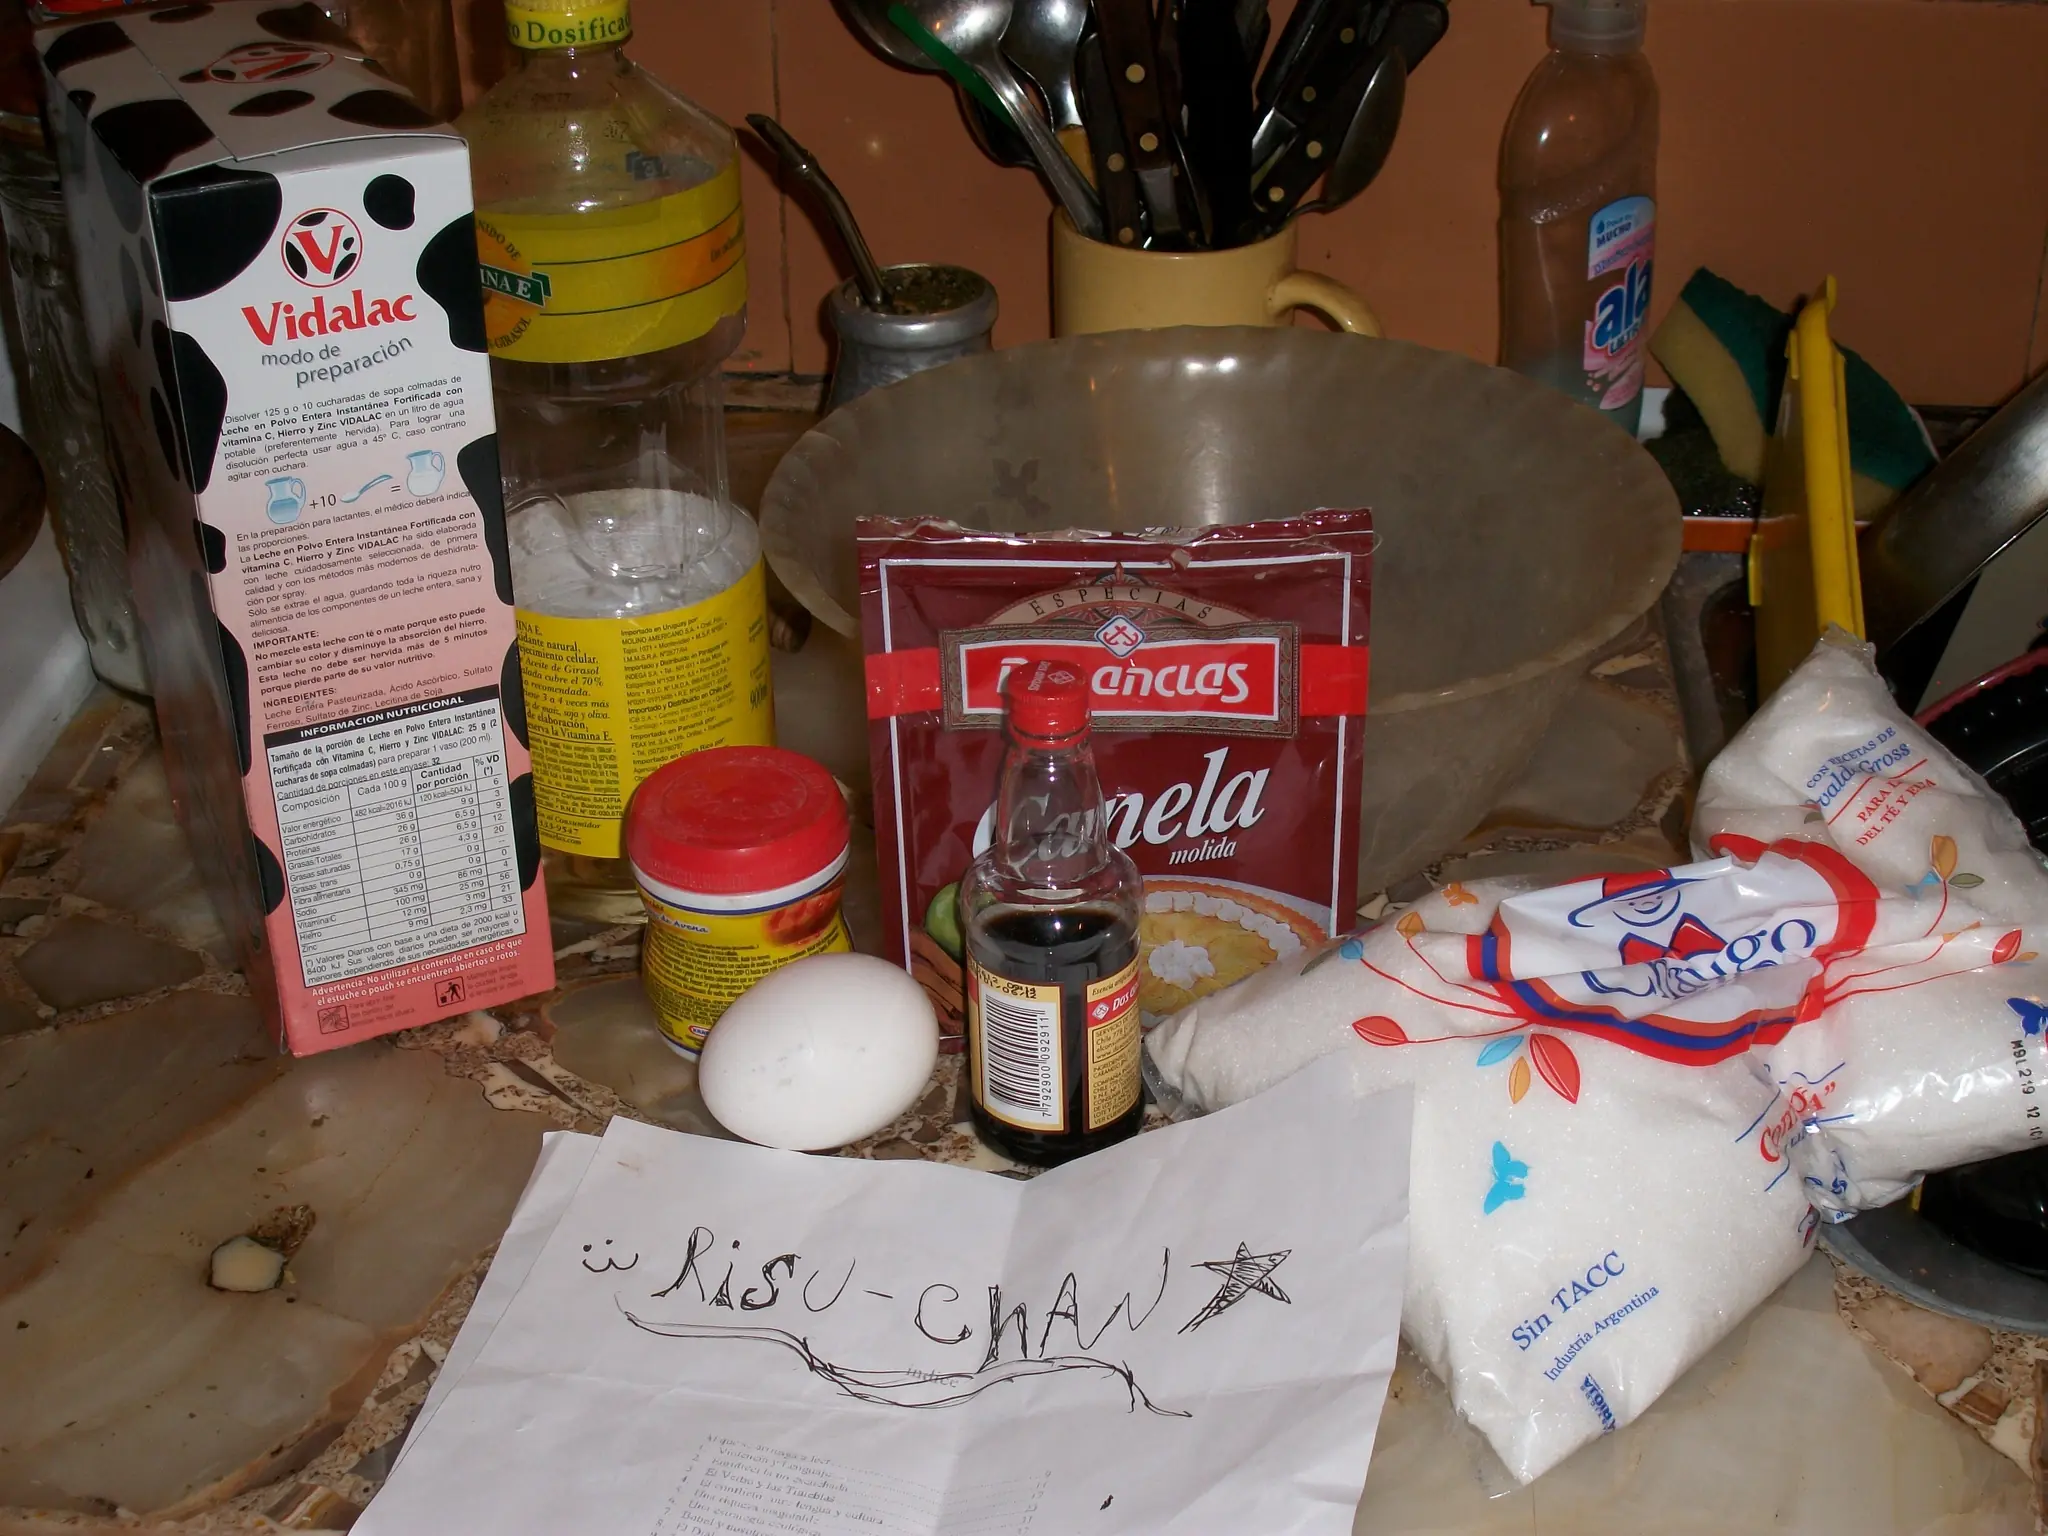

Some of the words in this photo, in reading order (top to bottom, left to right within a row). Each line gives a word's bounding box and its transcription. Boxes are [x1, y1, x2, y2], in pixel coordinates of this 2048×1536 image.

[292, 224, 345, 274] V
[505, 242, 522, 261] DE
[516, 278, 532, 299] E
[1593, 257, 1652, 349] ala
[240, 289, 417, 346] Vidalac
[494, 316, 532, 349] GIRASOL
[260, 348, 314, 367] modo
[318, 343, 341, 361] de
[296, 336, 414, 388] preparación
[221, 425, 249, 436] Leche
[254, 423, 266, 431] en
[270, 417, 297, 427] Polvo
[301, 411, 332, 422] Entera
[336, 400, 389, 416] Instantánea
[393, 390, 441, 405] Fortificada
[445, 387, 463, 396] con
[224, 412, 260, 425] Disolver
[264, 407, 281, 419] 125
[283, 407, 290, 416] g
[292, 405, 299, 413] o
[302, 401, 313, 412] 10
[315, 393, 366, 408] cucharadas
[368, 390, 380, 401] de
[383, 386, 404, 396] sopa
[407, 378, 448, 392] colmadas
[450, 375, 462, 385] de
[222, 435, 262, 447] vitamina
[264, 431, 275, 440] C,
[277, 427, 306, 438] Hierro
[308, 425, 314, 434] y
[317, 421, 337, 431] Zinc
[339, 411, 382, 426] VIDALAC
[384, 410, 396, 418] en
[398, 408, 409, 416] un
[411, 405, 427, 413] litro
[429, 402, 440, 410] de
[443, 398, 464, 408] agua
[1028, 586, 1212, 620] ESPECIAS
[253, 630, 319, 650] IMPORTANTE:
[255, 652, 268, 661] No
[269, 645, 301, 658] mezcle
[302, 642, 321, 652] esta
[322, 637, 346, 647] leche
[347, 633, 365, 642] con
[365, 629, 374, 638] té
[383, 624, 405, 634] mate
[406, 617, 437, 631] porque
[438, 612, 458, 622] esto
[458, 606, 486, 619] puede
[551, 663, 561, 672] de
[564, 665, 599, 675] Girasol
[566, 652, 599, 665] celular.
[531, 680, 591, 697] recomendada.
[570, 676, 578, 685] el
[263, 687, 336, 708] INGREDIENTES:
[565, 700, 588, 708] veces
[300, 713, 384, 738] INFORMACION
[386, 696, 464, 719] NUTRICIONAL
[559, 728, 601, 741] Vitamina
[420, 762, 462, 779] Cantidad
[486, 754, 500, 764] VD
[1806, 765, 1831, 789] CON
[1828, 740, 1877, 766] RECETAS
[1876, 726, 1896, 745] DE
[1858, 743, 1911, 774] Gross
[357, 784, 381, 796] Cada
[383, 778, 399, 790] 100
[400, 777, 407, 788] g
[416, 781, 432, 792] por
[433, 772, 469, 788] porción
[281, 793, 340, 813] Composición
[1857, 789, 1892, 823] PARA
[1856, 824, 1885, 846] DEL
[1880, 804, 1901, 825] TÉ
[1896, 795, 1909, 808] Y
[1168, 836, 1238, 866] molida
[674, 919, 709, 933] Avena
[312, 976, 366, 997] Advertencia:
[366, 973, 379, 984] No
[379, 968, 410, 981] utilizar
[411, 962, 419, 973] el
[420, 951, 462, 971] contenido
[463, 949, 474, 959] en
[475, 943, 494, 956] caso
[494, 941, 505, 951] de
[506, 938, 522, 949] que
[317, 996, 325, 1008] el
[326, 990, 359, 1005] estuche
[360, 987, 367, 996] o
[368, 980, 395, 996] pouch
[394, 979, 405, 987] se
[406, 966, 453, 985] encuentren
[454, 956, 488, 972] abiertos
[496, 947, 520, 960] rotos.
[1112, 994, 1129, 1012] Dos
[1511, 1313, 1553, 1351] Sin
[1550, 1250, 1625, 1314] TACC
[1543, 1329, 1594, 1382] Industria
[1594, 1285, 1660, 1335] Argentina
